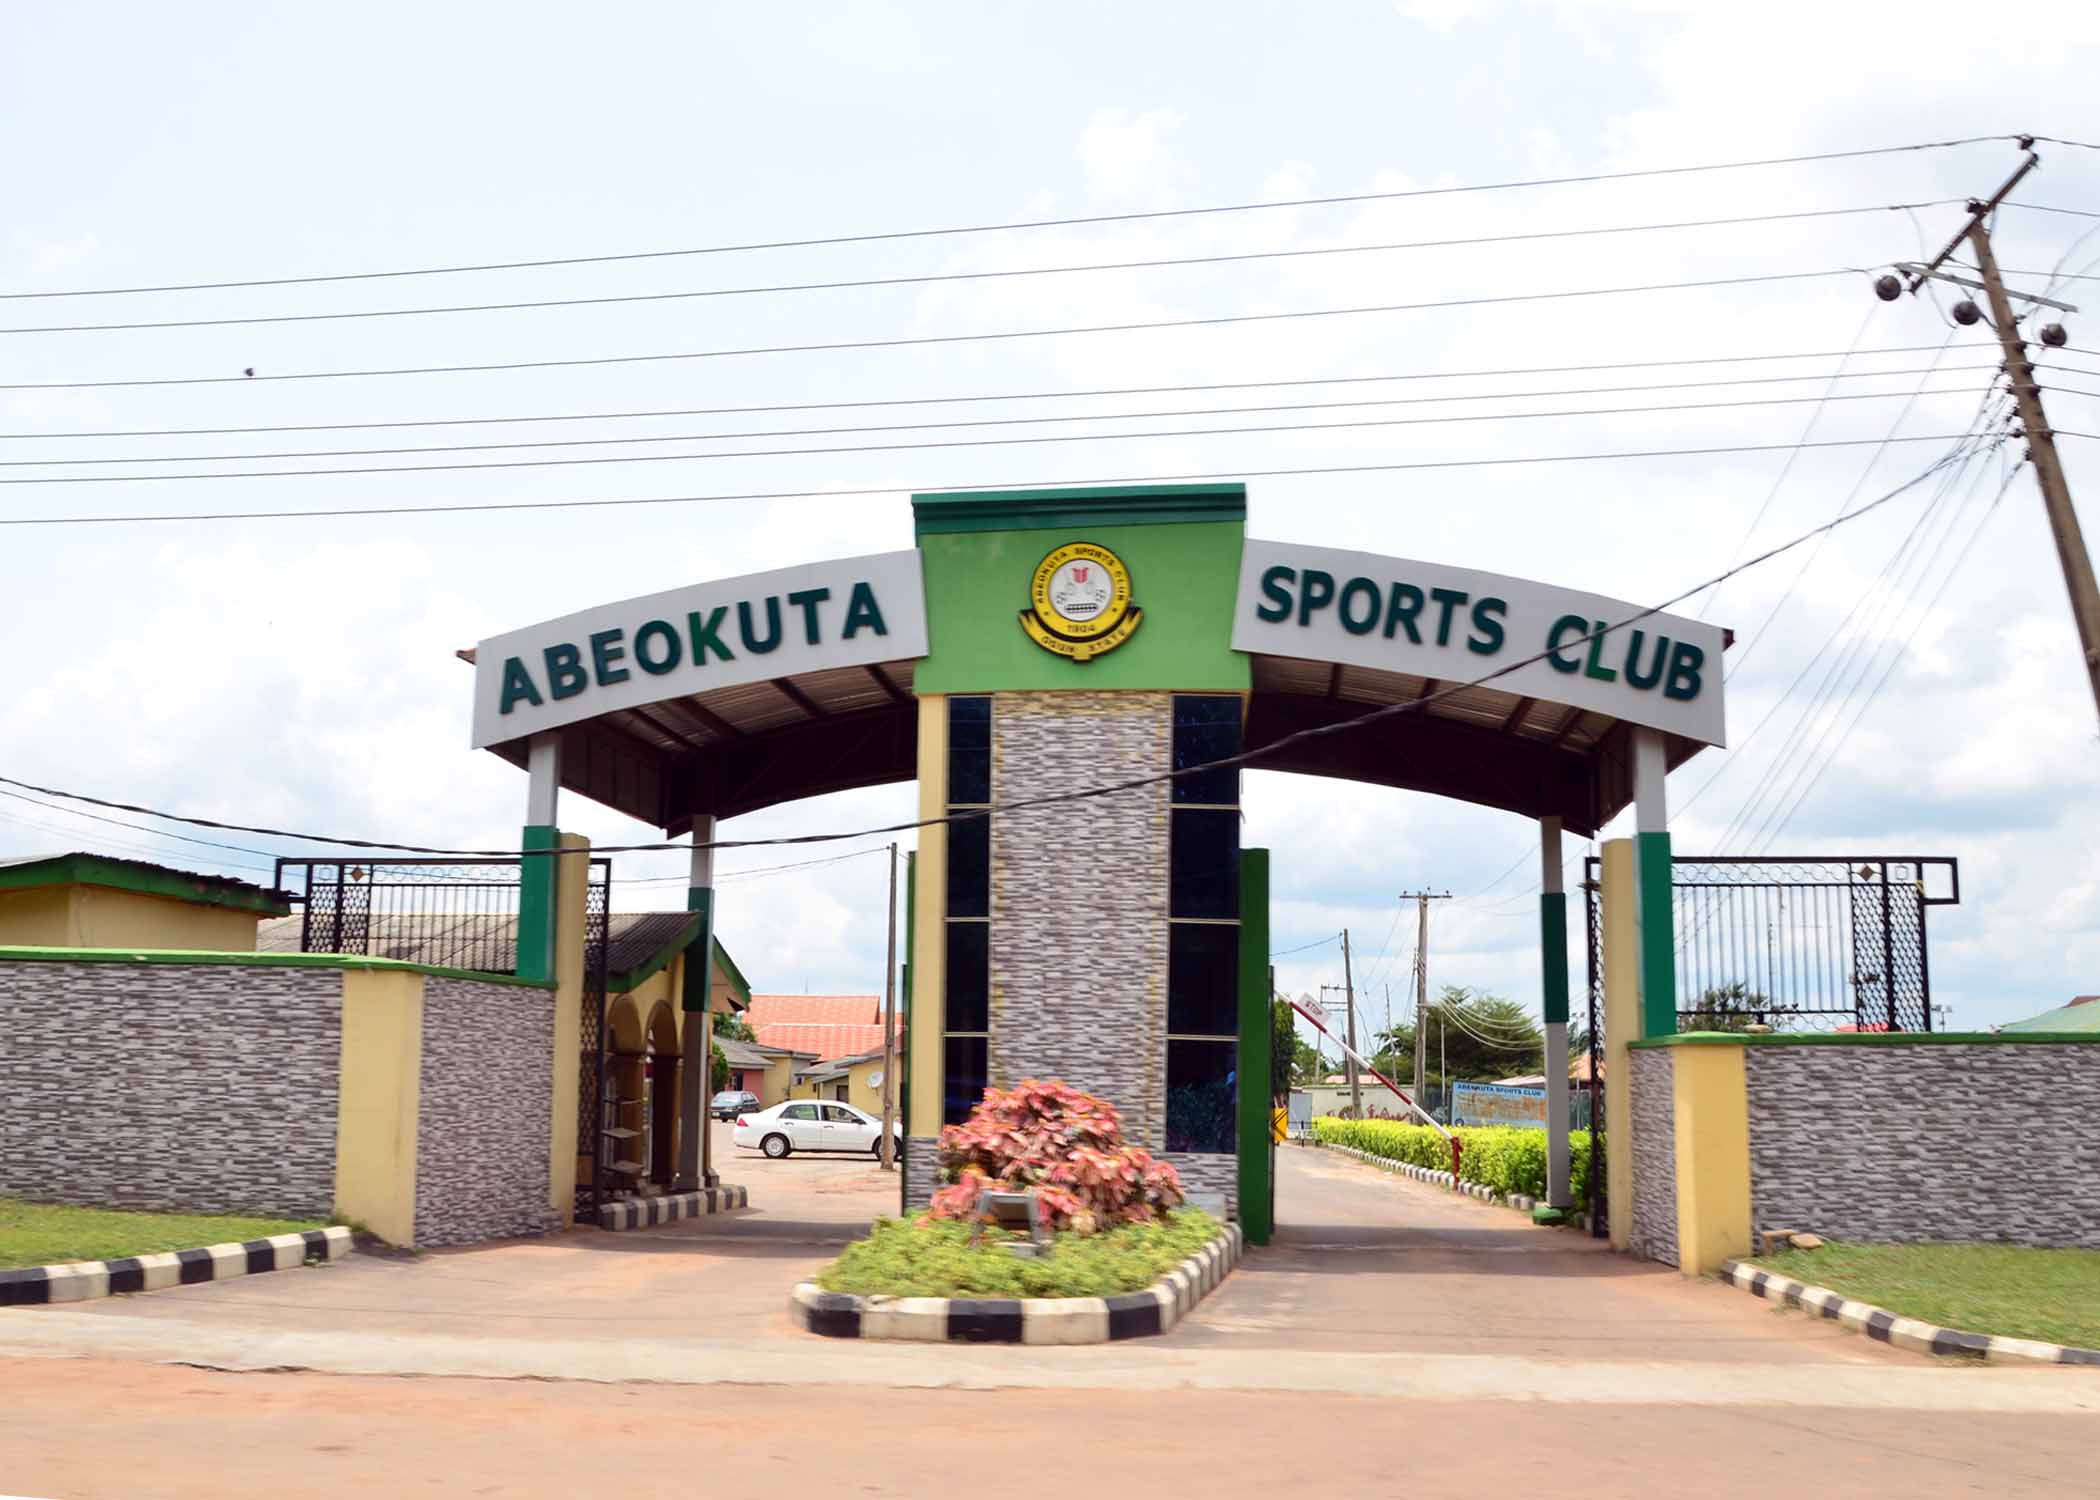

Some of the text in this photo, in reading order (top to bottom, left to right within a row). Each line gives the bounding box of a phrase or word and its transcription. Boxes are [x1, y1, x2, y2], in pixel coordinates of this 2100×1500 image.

[499, 581, 888, 715] ABEOKUTA
[1088, 629, 1125, 651] STATE
[1256, 565, 1705, 701] SPORTS CLUB
[1496, 1086, 1521, 1095] SPORTS
[1523, 1089, 1542, 1097] CLUB
